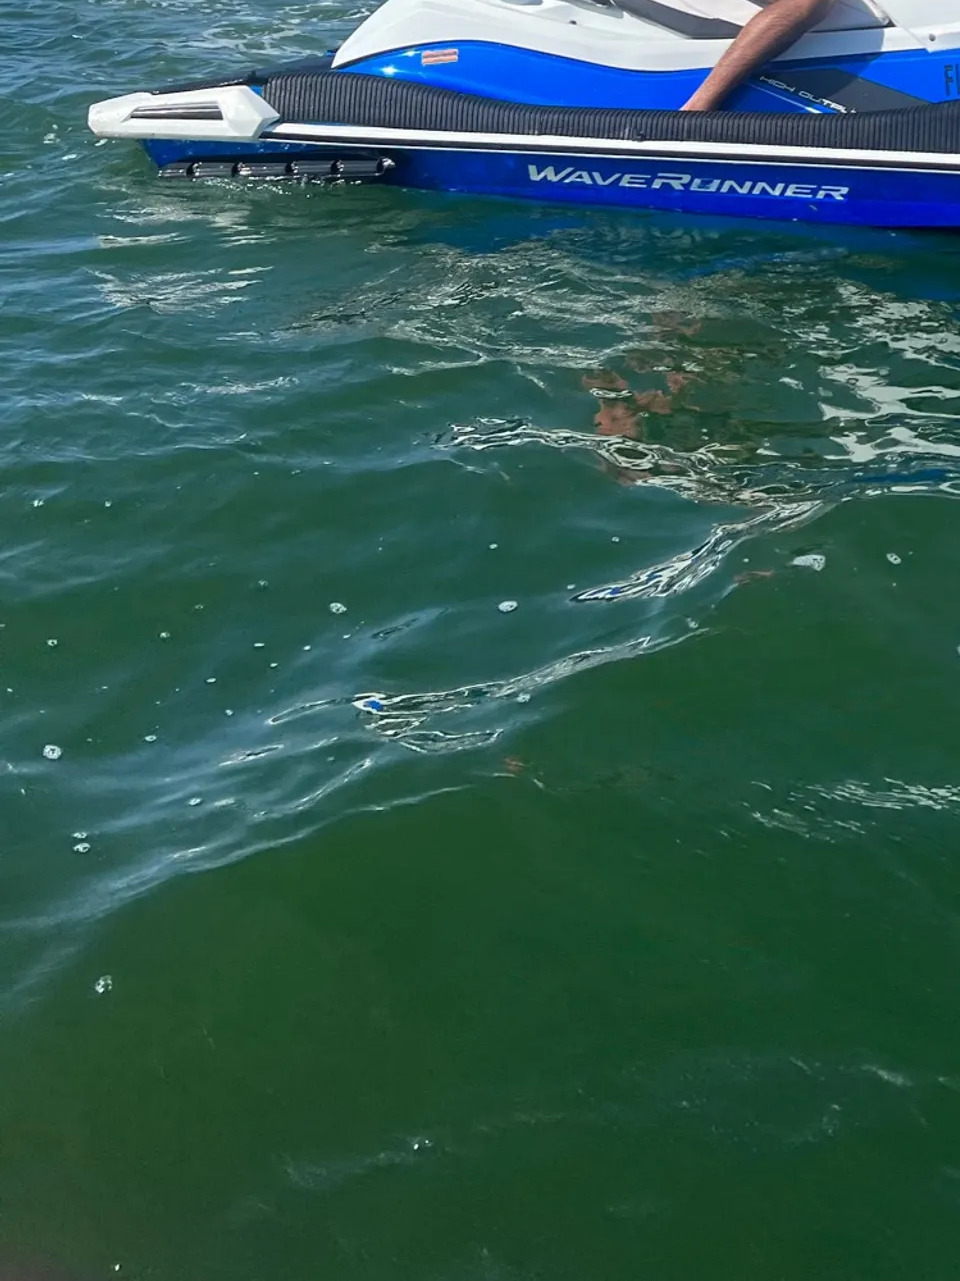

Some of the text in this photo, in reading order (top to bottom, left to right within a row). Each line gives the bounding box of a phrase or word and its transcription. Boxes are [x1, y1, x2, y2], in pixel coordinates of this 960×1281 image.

[759, 75, 858, 114] HIGH OUTPU
[527, 164, 849, 200] WAVERUNNER
